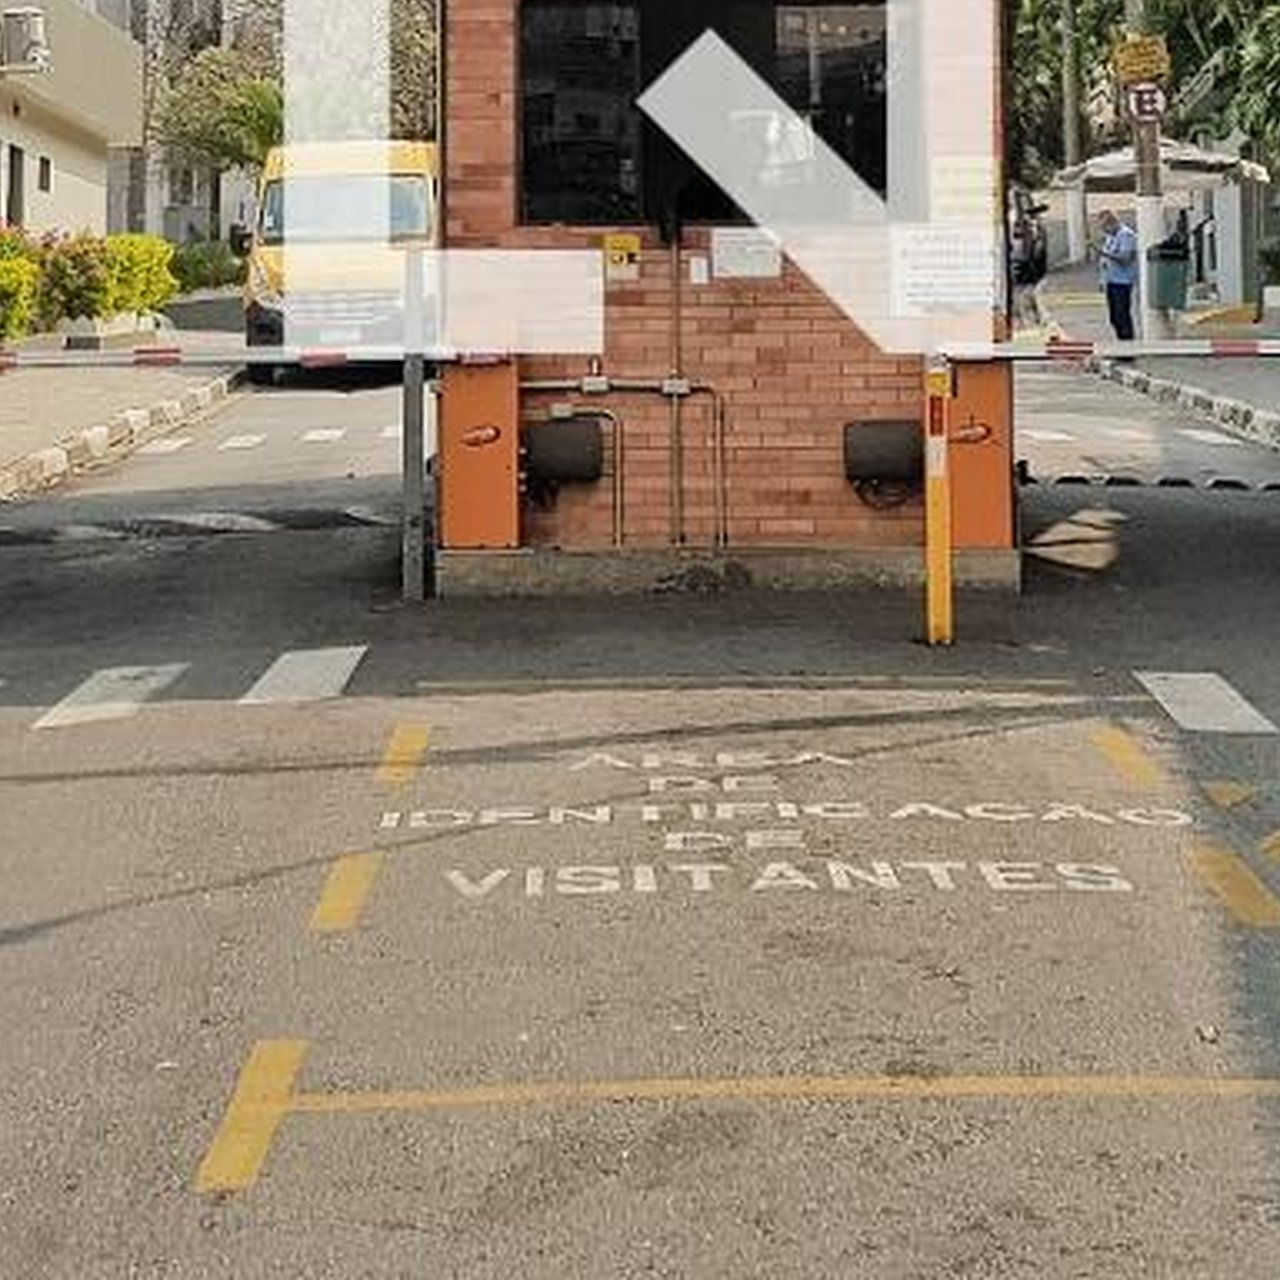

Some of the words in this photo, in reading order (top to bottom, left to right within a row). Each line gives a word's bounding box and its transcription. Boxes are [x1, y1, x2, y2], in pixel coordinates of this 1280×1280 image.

[648, 774, 780, 792] DE
[662, 829, 808, 851] DE
[443, 861, 1135, 898] VISITANTES
